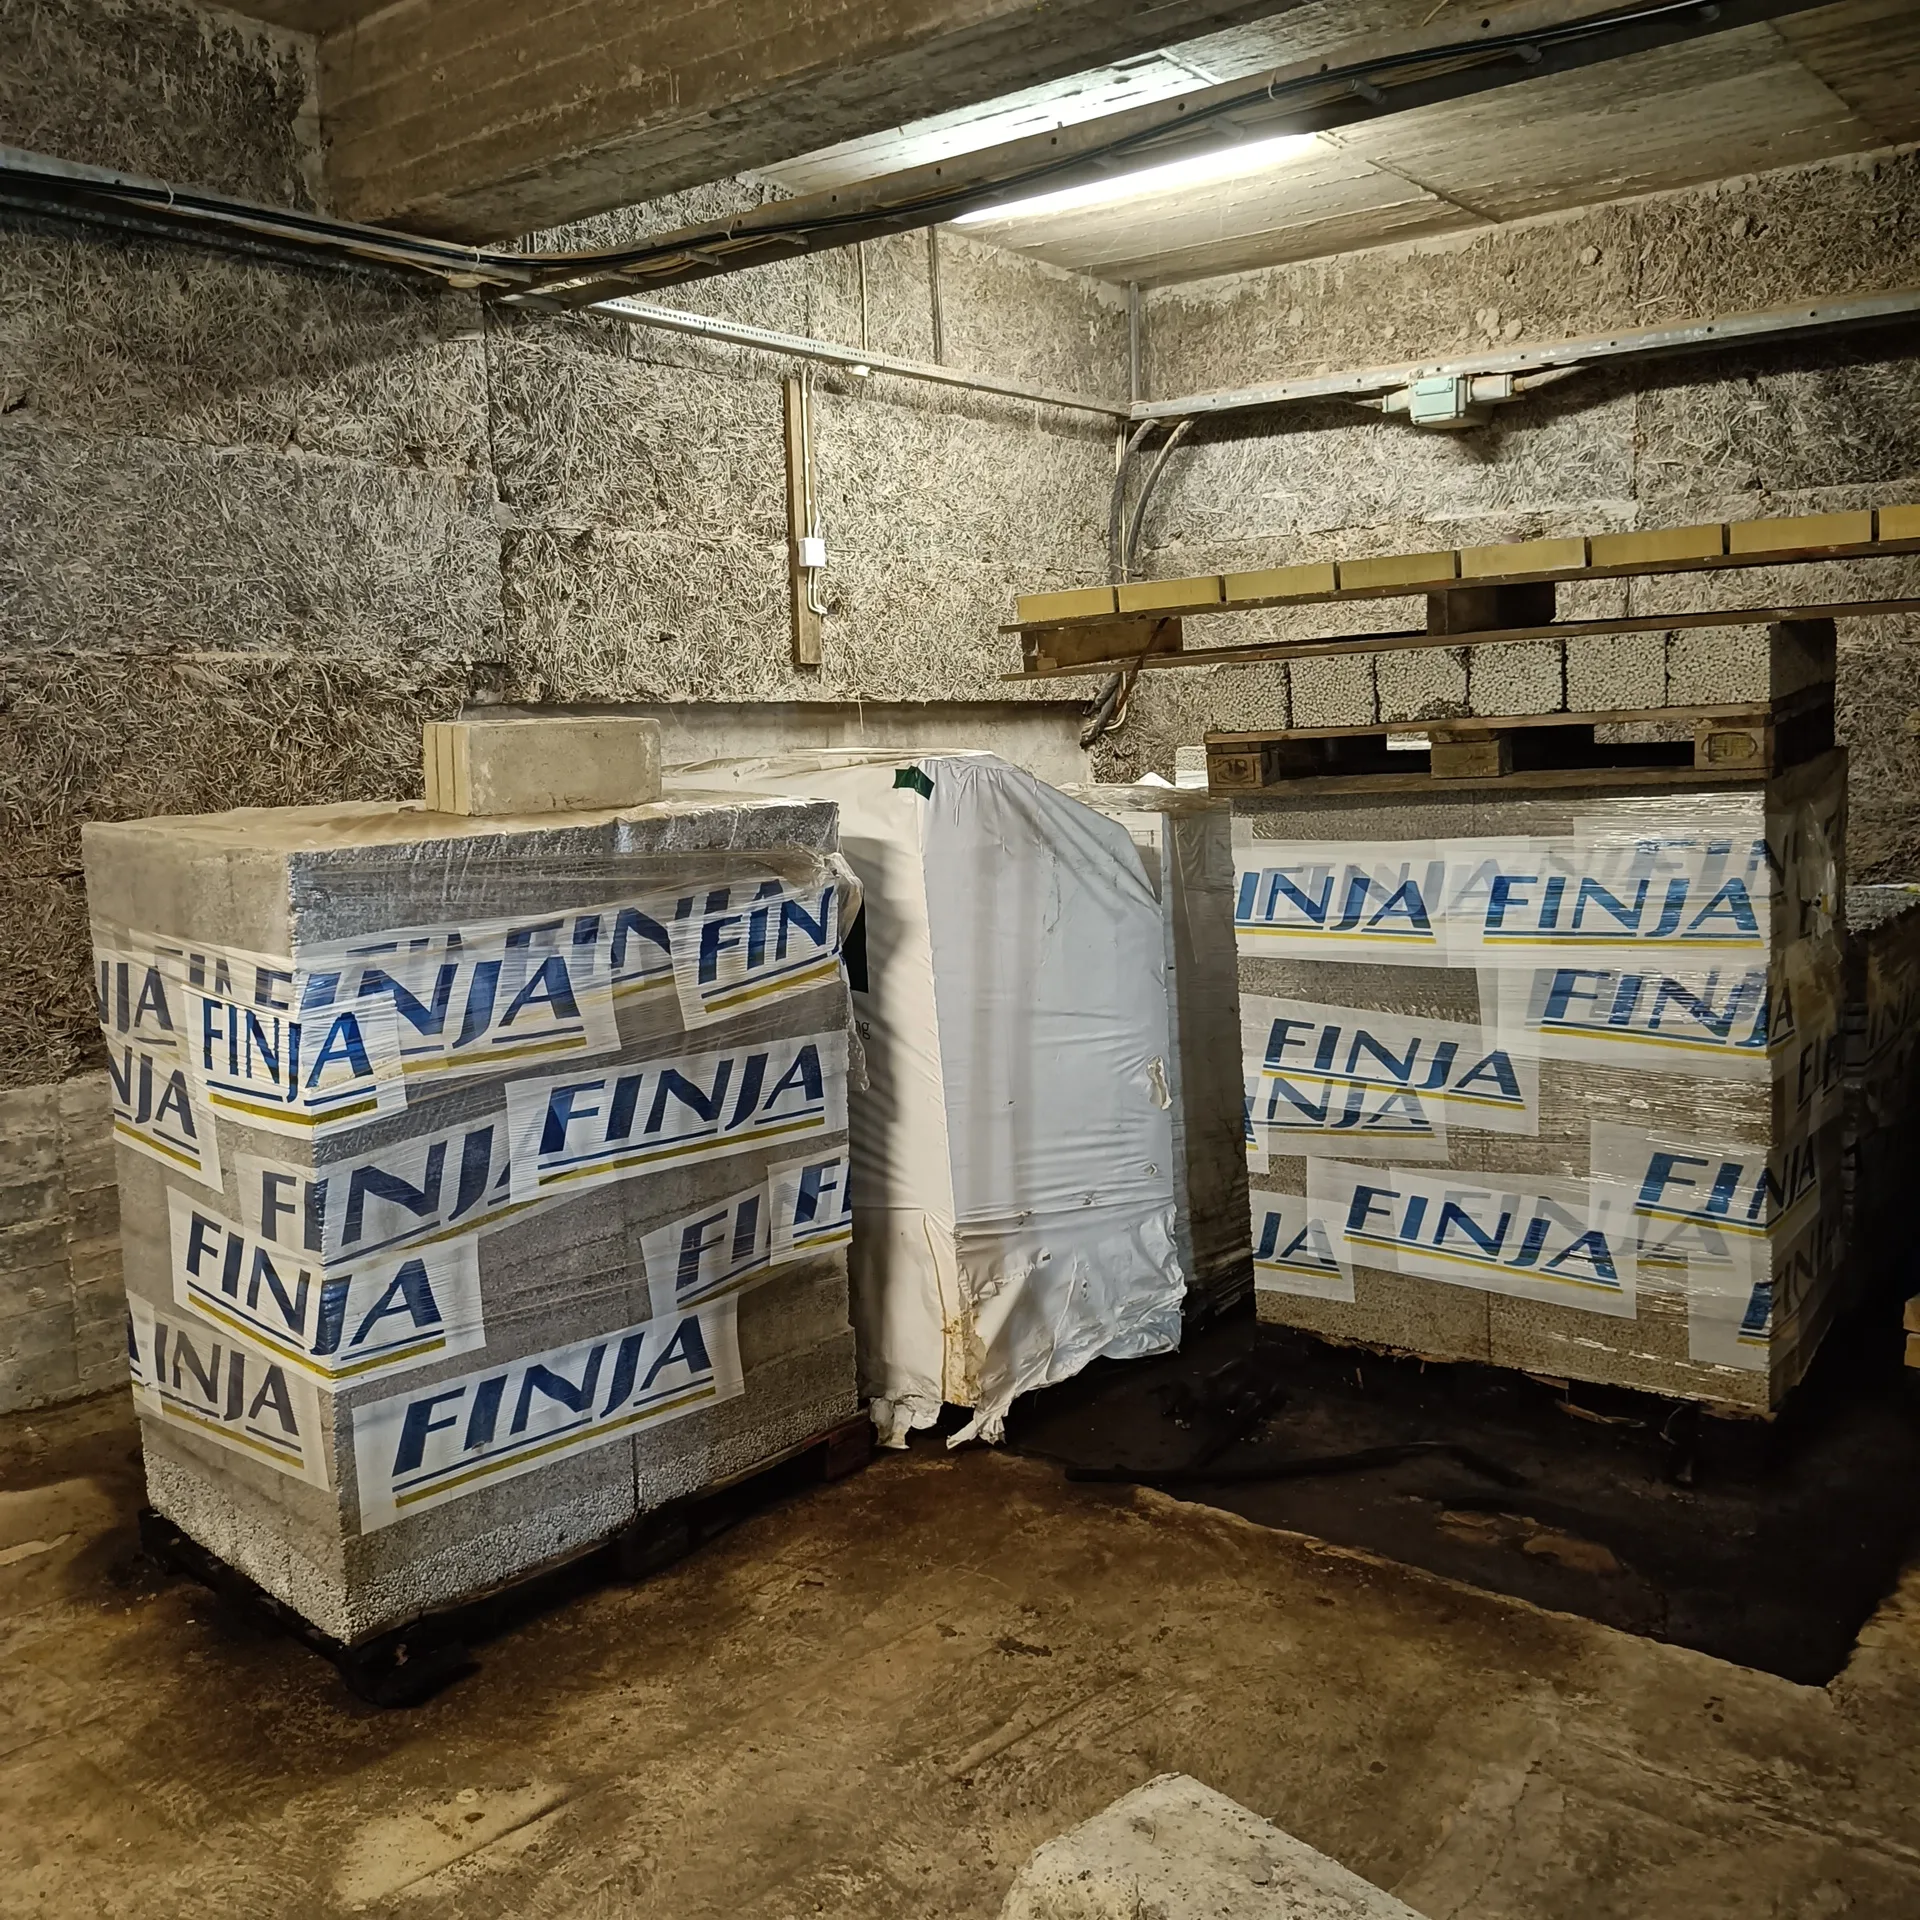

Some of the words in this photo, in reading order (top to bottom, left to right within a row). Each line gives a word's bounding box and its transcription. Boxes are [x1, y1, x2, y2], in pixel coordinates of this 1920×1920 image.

[698, 885, 840, 985] FIN
[1484, 875, 1760, 938] FINJA
[202, 997, 375, 1103] FINJA
[538, 1044, 824, 1155] FINJA
[1265, 1018, 1522, 1097] FINJA
[186, 1210, 443, 1356] FINJA
[676, 1194, 771, 1291] FI
[1346, 1185, 1618, 1280] FINJA
[152, 1322, 300, 1437] INJA
[392, 1314, 712, 1478] FINJA
